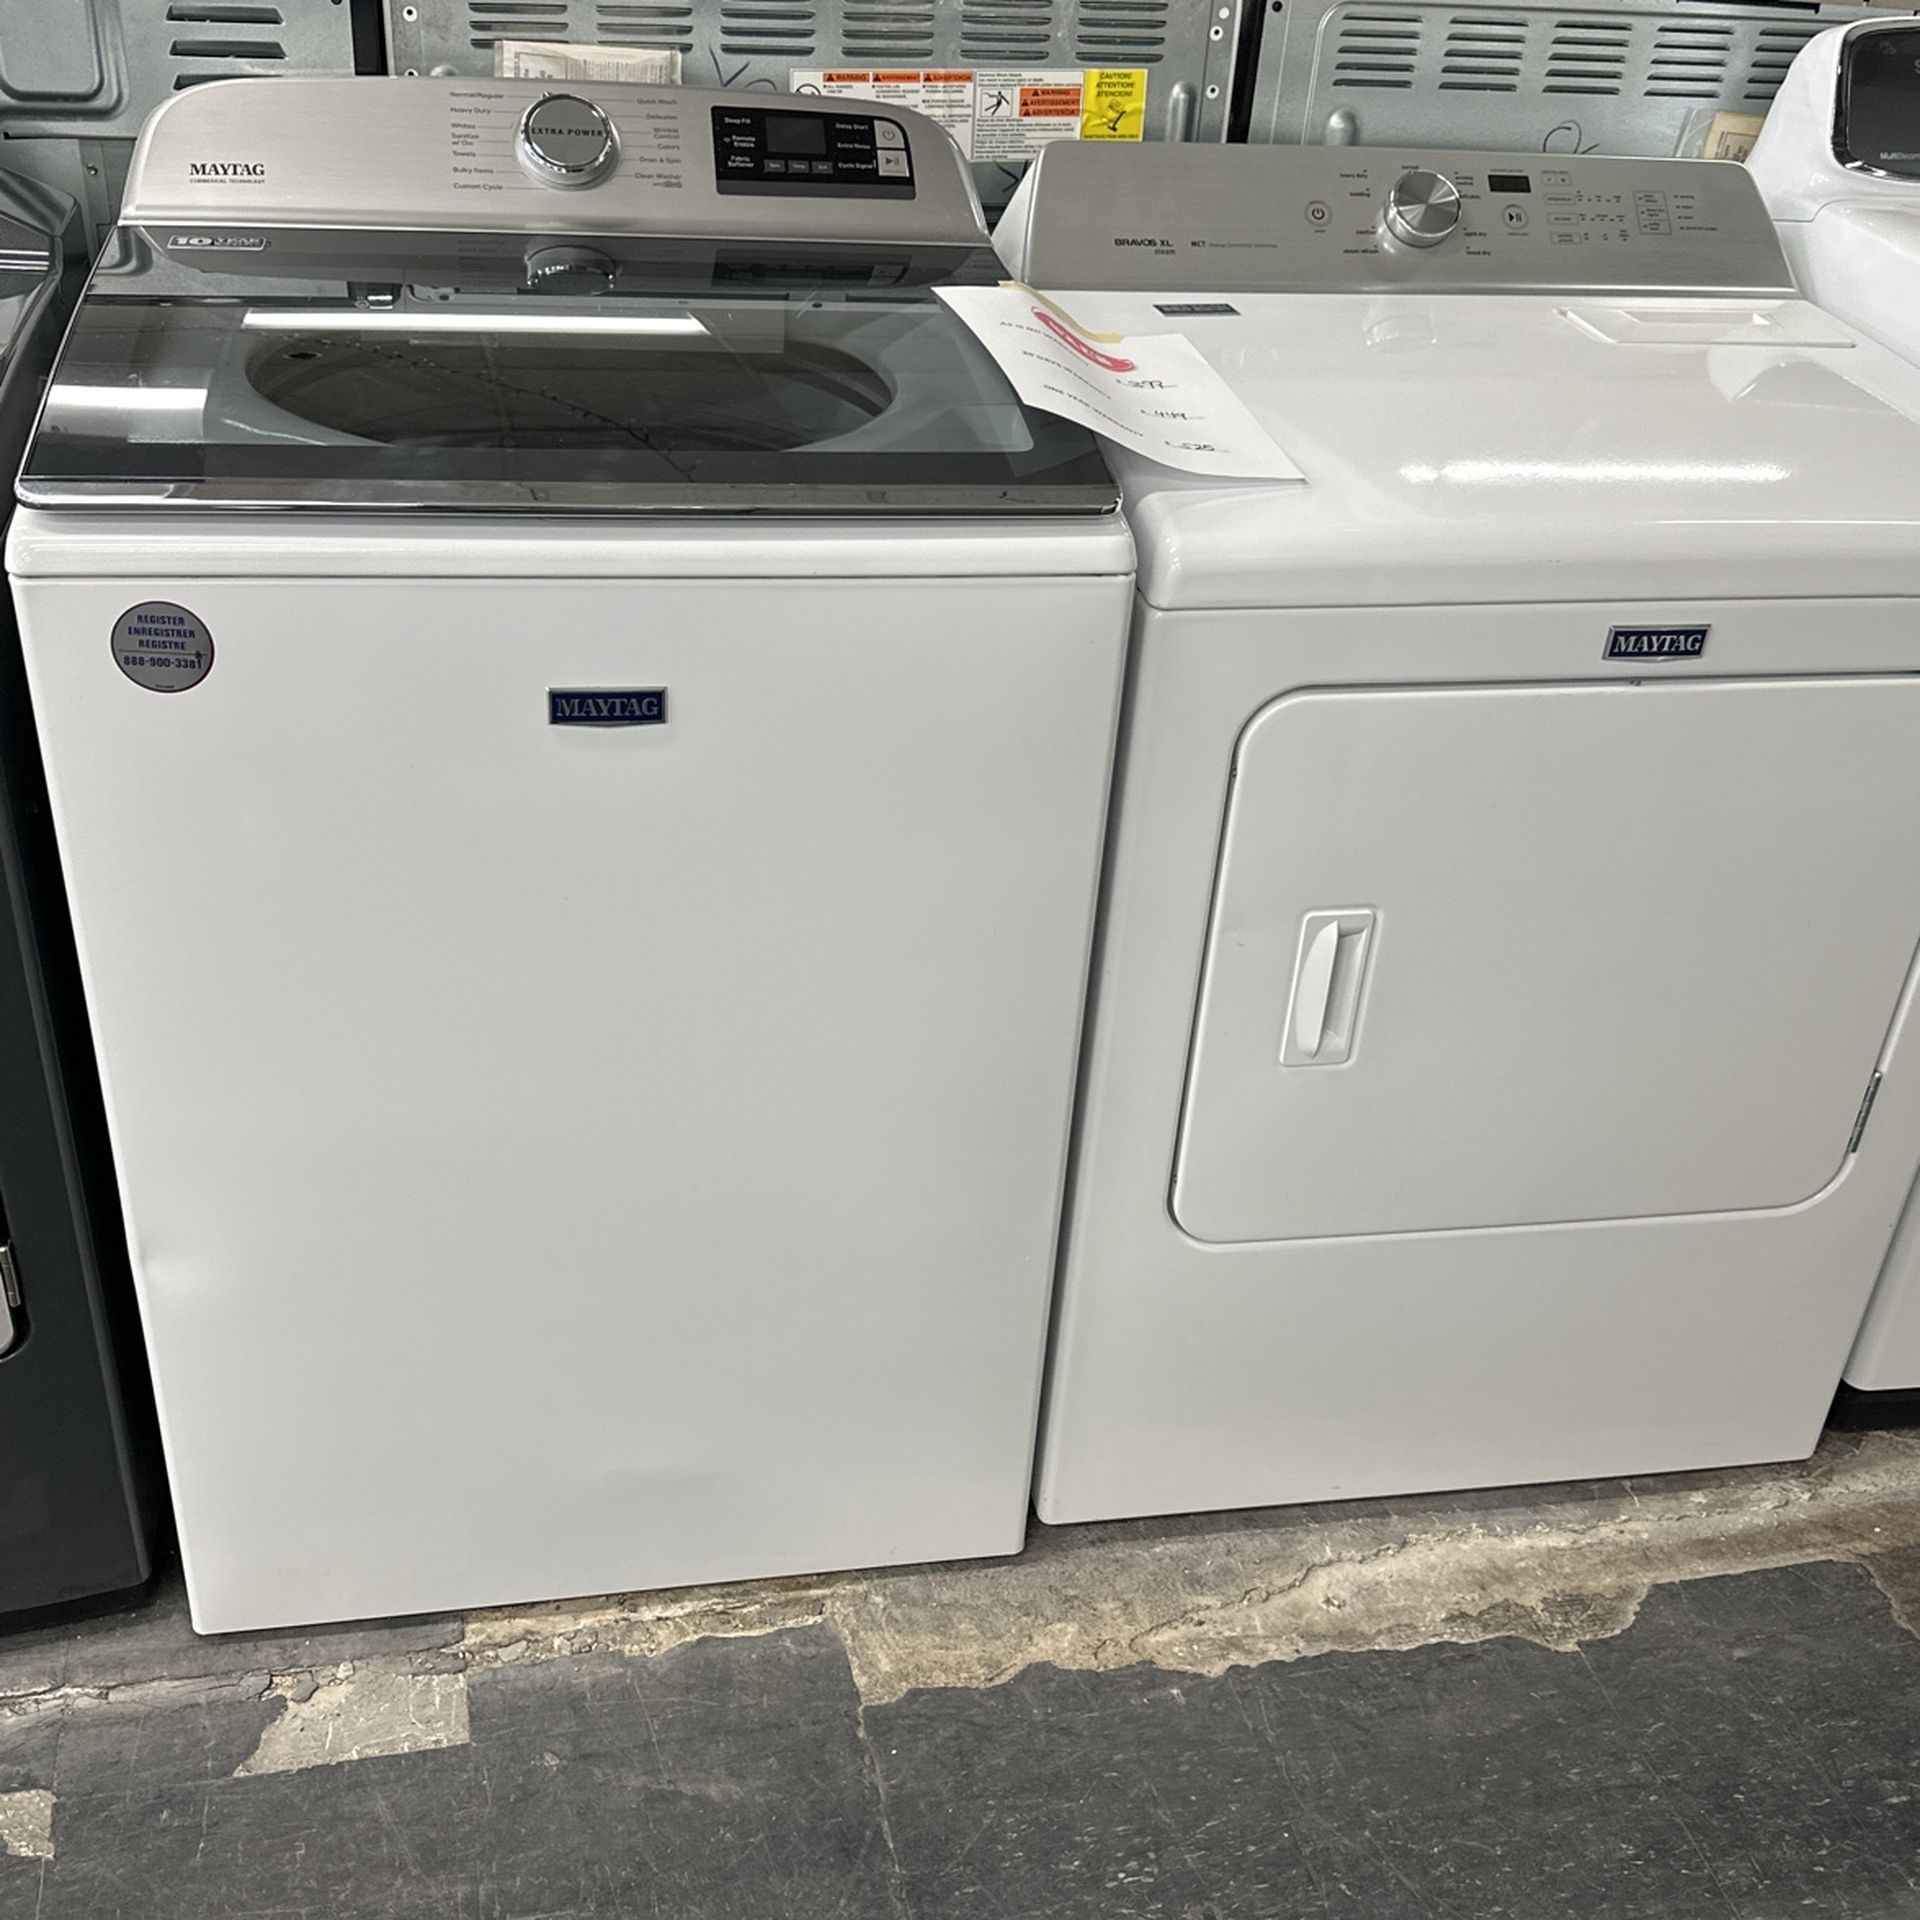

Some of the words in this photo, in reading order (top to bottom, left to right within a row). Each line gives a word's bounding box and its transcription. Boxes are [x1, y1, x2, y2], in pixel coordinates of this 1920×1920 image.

[531, 127, 564, 136] EXTRA
[567, 128, 604, 137] POWER
[189, 163, 265, 176] MAYTAG
[1113, 238, 1158, 248] BRAVOS
[1190, 240, 1206, 248] MCT
[137, 614, 185, 625] REGISTER
[128, 627, 195, 638] ENREGISTRER
[139, 639, 187, 650] REGISTRE
[1612, 633, 1703, 654] MAYTAG
[124, 656, 202, 669] 888-900-3381
[555, 697, 660, 718] MAYTAG
